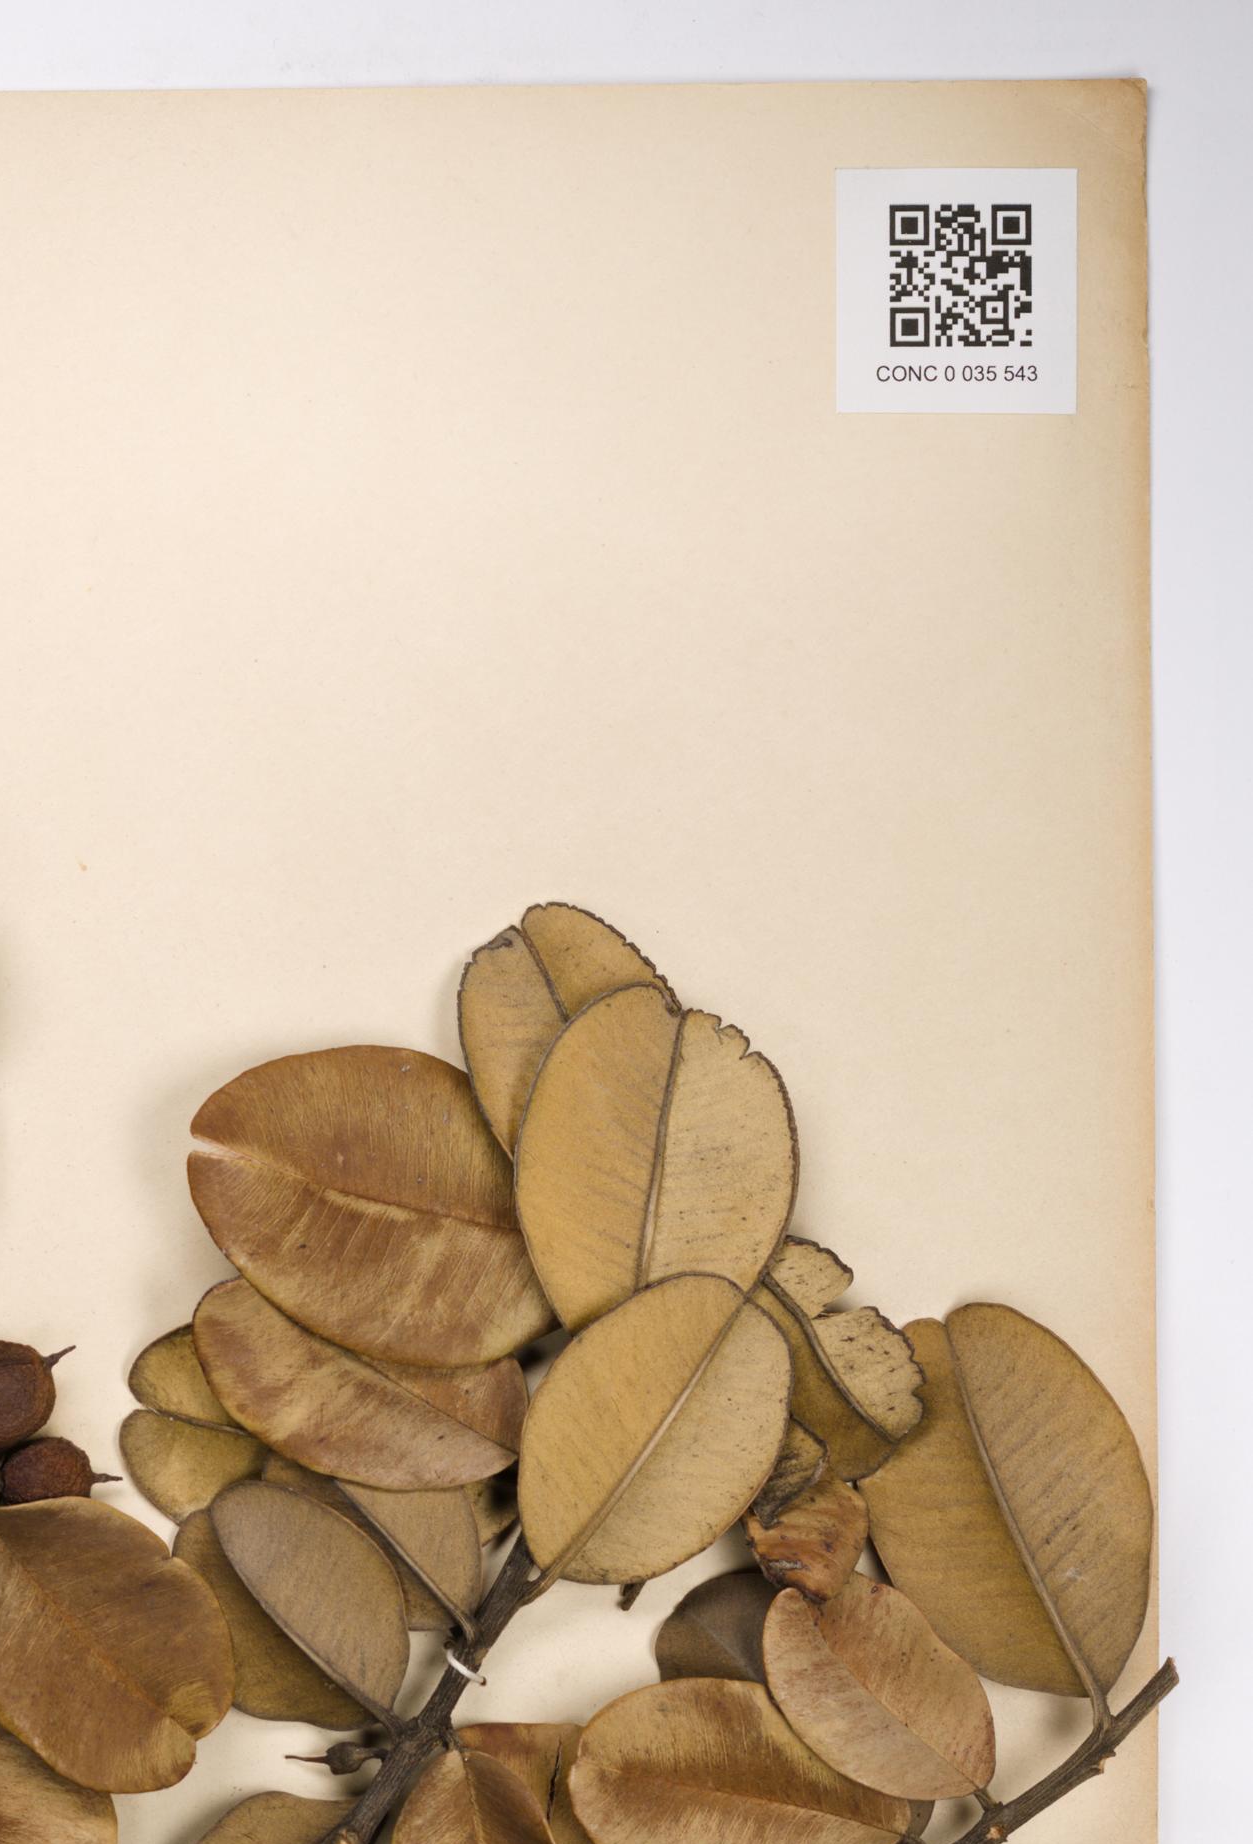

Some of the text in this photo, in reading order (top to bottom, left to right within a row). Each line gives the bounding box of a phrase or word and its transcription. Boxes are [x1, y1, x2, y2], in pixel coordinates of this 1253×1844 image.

[876, 365, 1038, 382] CONC 0 035 543
